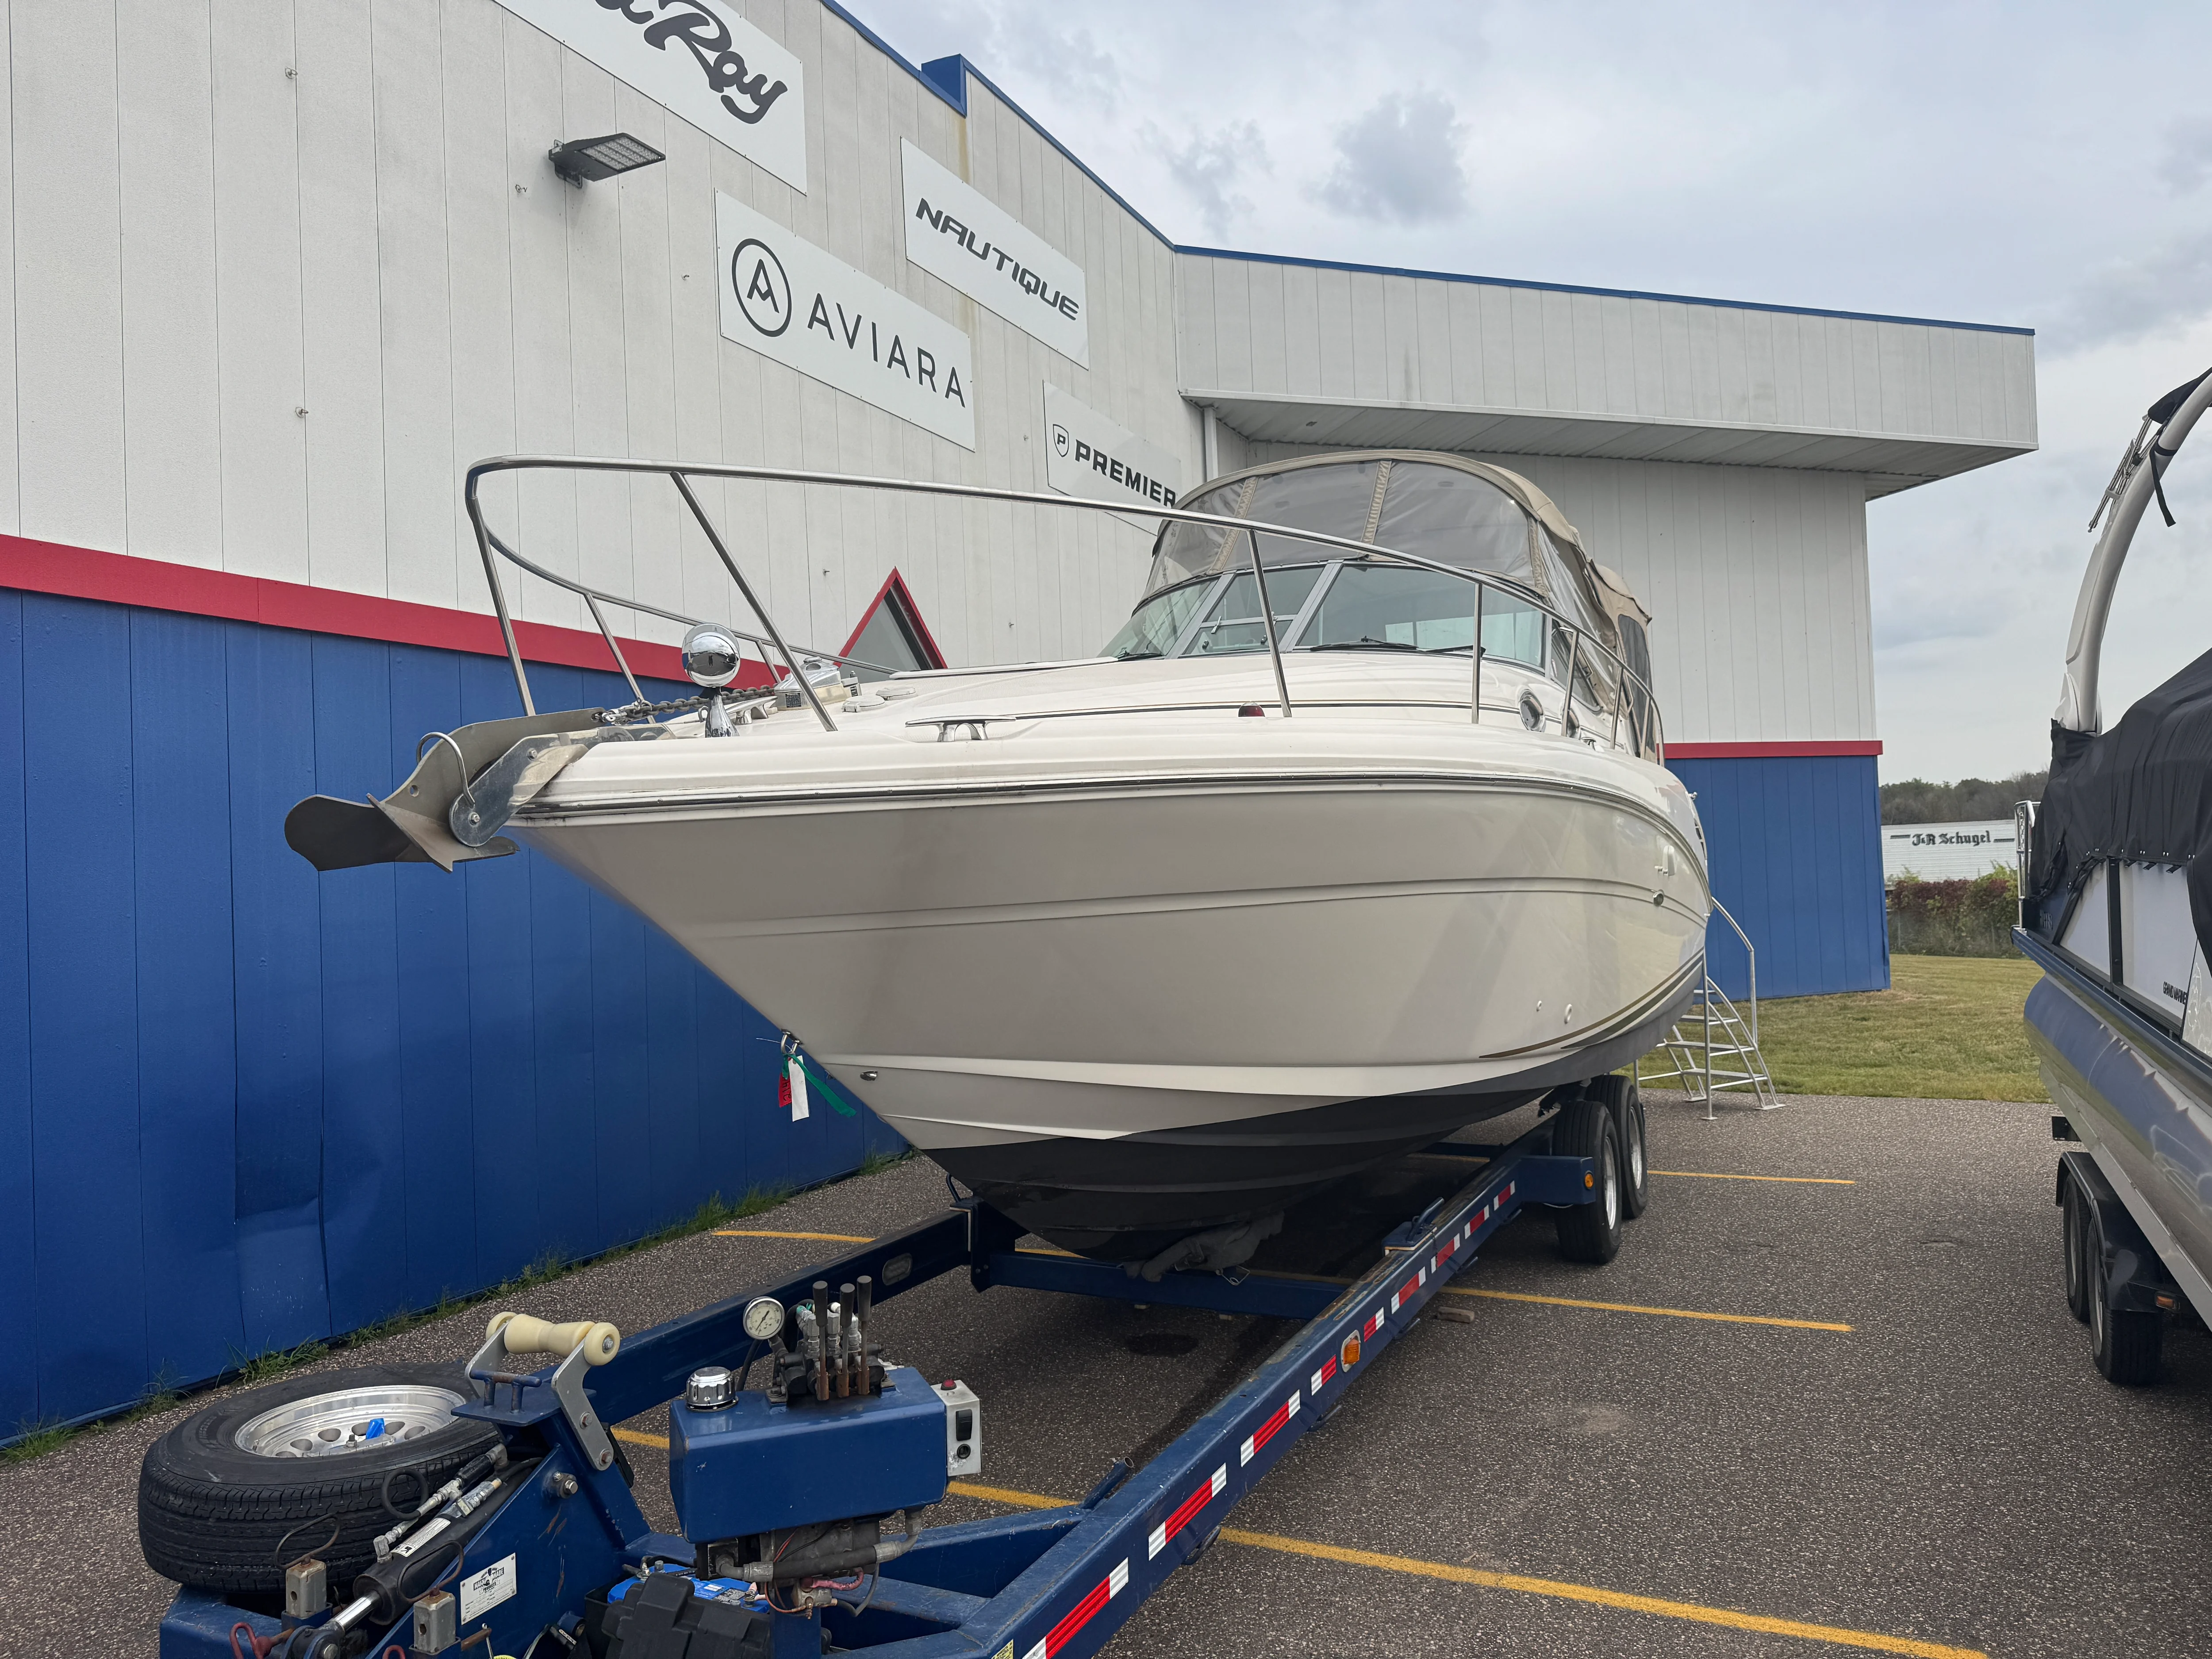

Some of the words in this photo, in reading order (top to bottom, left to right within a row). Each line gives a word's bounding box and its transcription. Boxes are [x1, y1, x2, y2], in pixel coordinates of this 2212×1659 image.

[916, 198, 1079, 321] NAUTIQUE
[807, 293, 965, 408] AVIARA
[1057, 433, 1066, 445] P
[1075, 439, 1176, 508] PREMIER
[1938, 830, 1991, 847] Schugel
